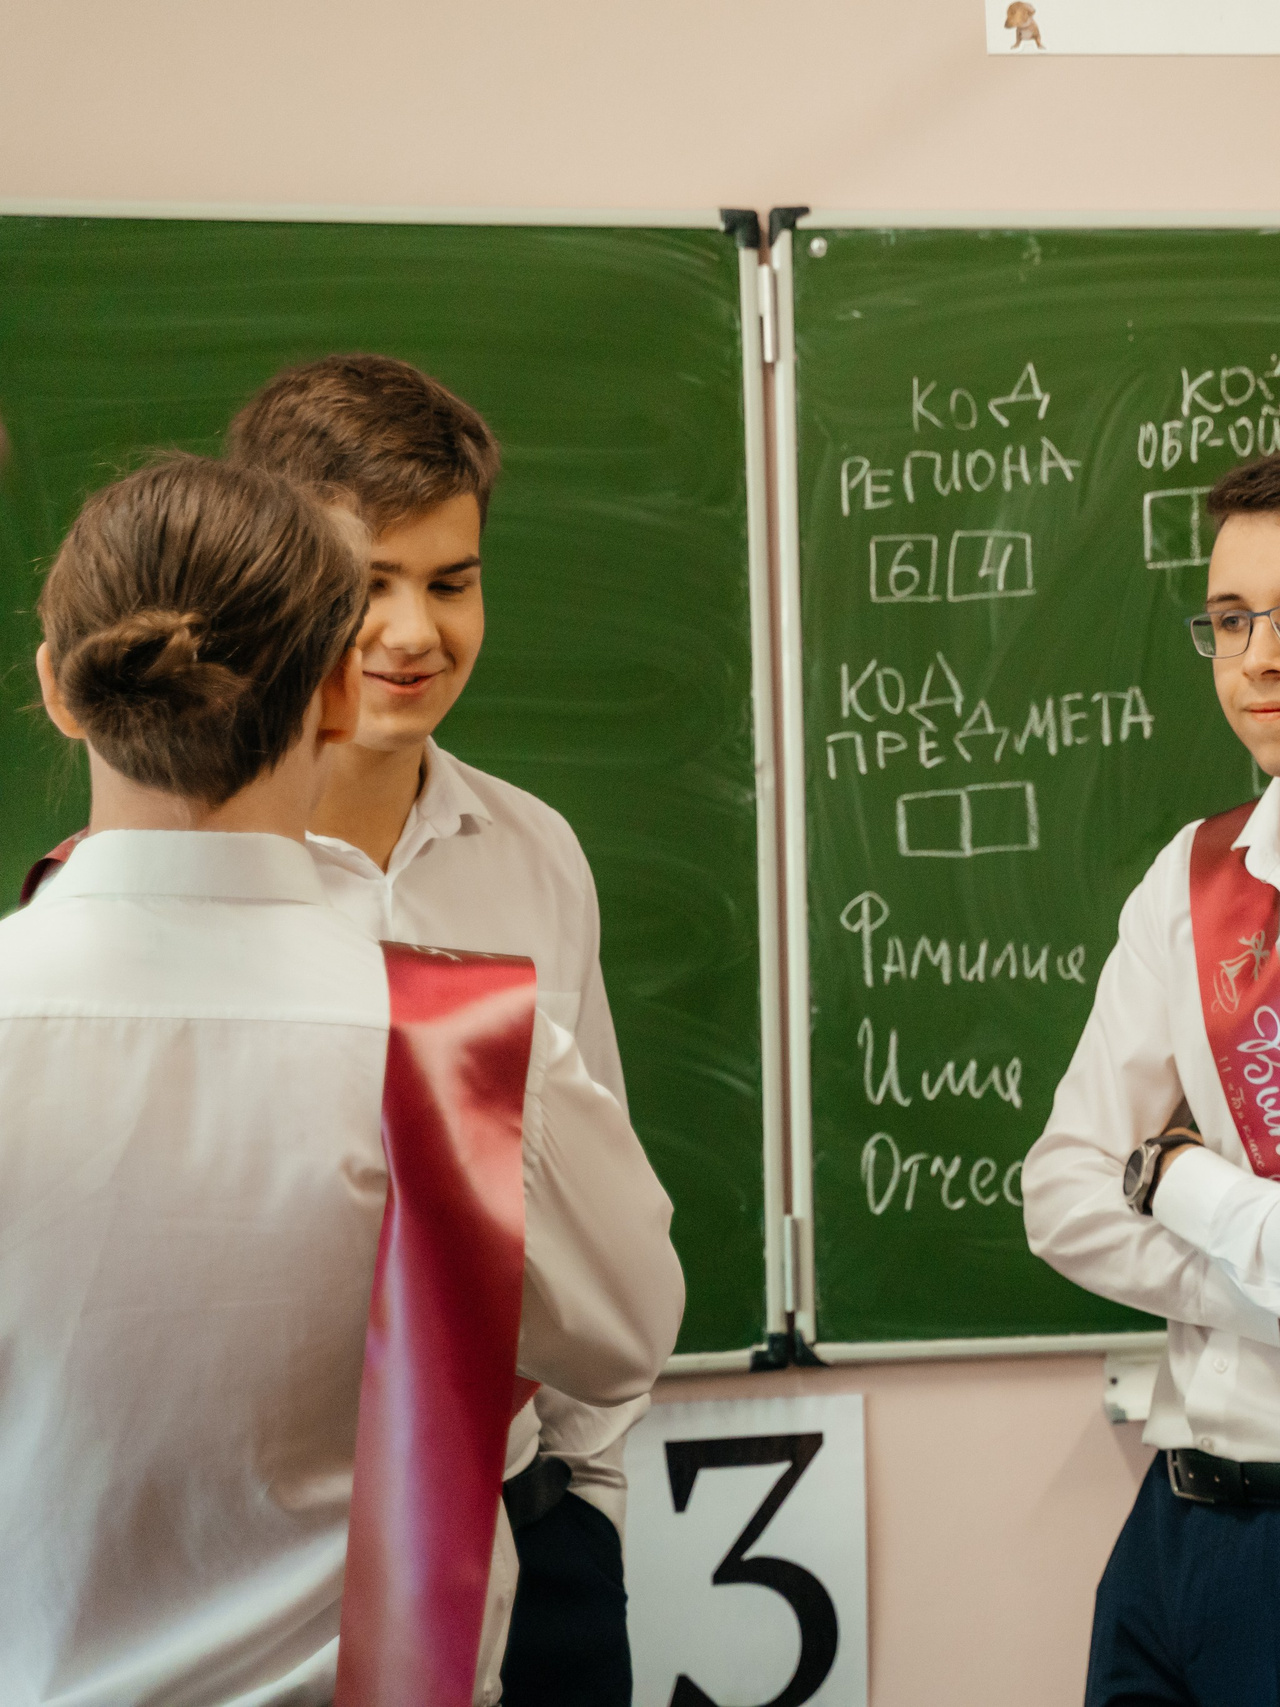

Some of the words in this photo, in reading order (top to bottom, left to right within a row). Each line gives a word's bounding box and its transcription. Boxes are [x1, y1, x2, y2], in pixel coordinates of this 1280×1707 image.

[912, 361, 1051, 432] КОД
[825, 686, 1155, 779] ПРЕДМЕТА
[840, 651, 963, 732] КОД
[663, 1430, 839, 1707] 3
